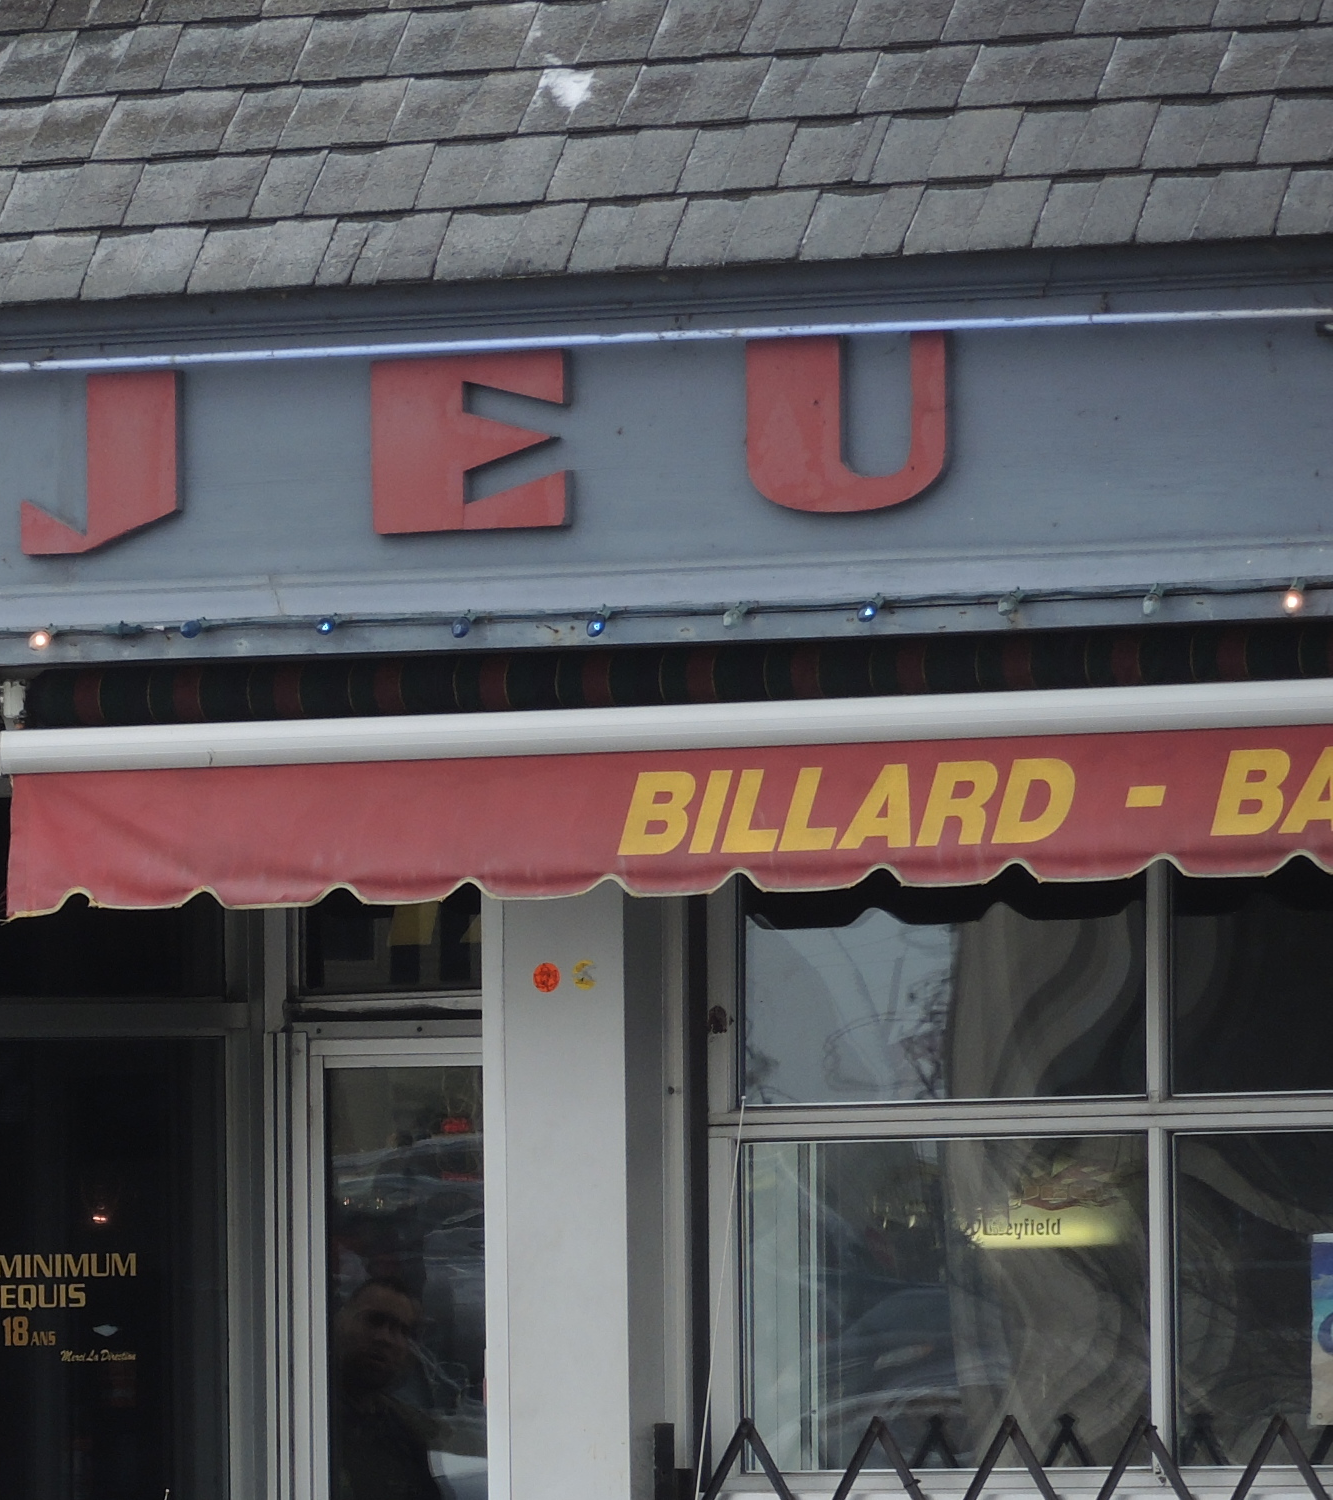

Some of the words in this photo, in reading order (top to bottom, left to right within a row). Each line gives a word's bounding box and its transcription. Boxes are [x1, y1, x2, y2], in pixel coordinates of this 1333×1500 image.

[617, 757, 1077, 857] BILLARD
[2, 1316, 29, 1347] 18
[31, 1331, 57, 1347] ANS
[60, 1349, 85, 1362] Merci
[99, 1349, 137, 1362] Direction
